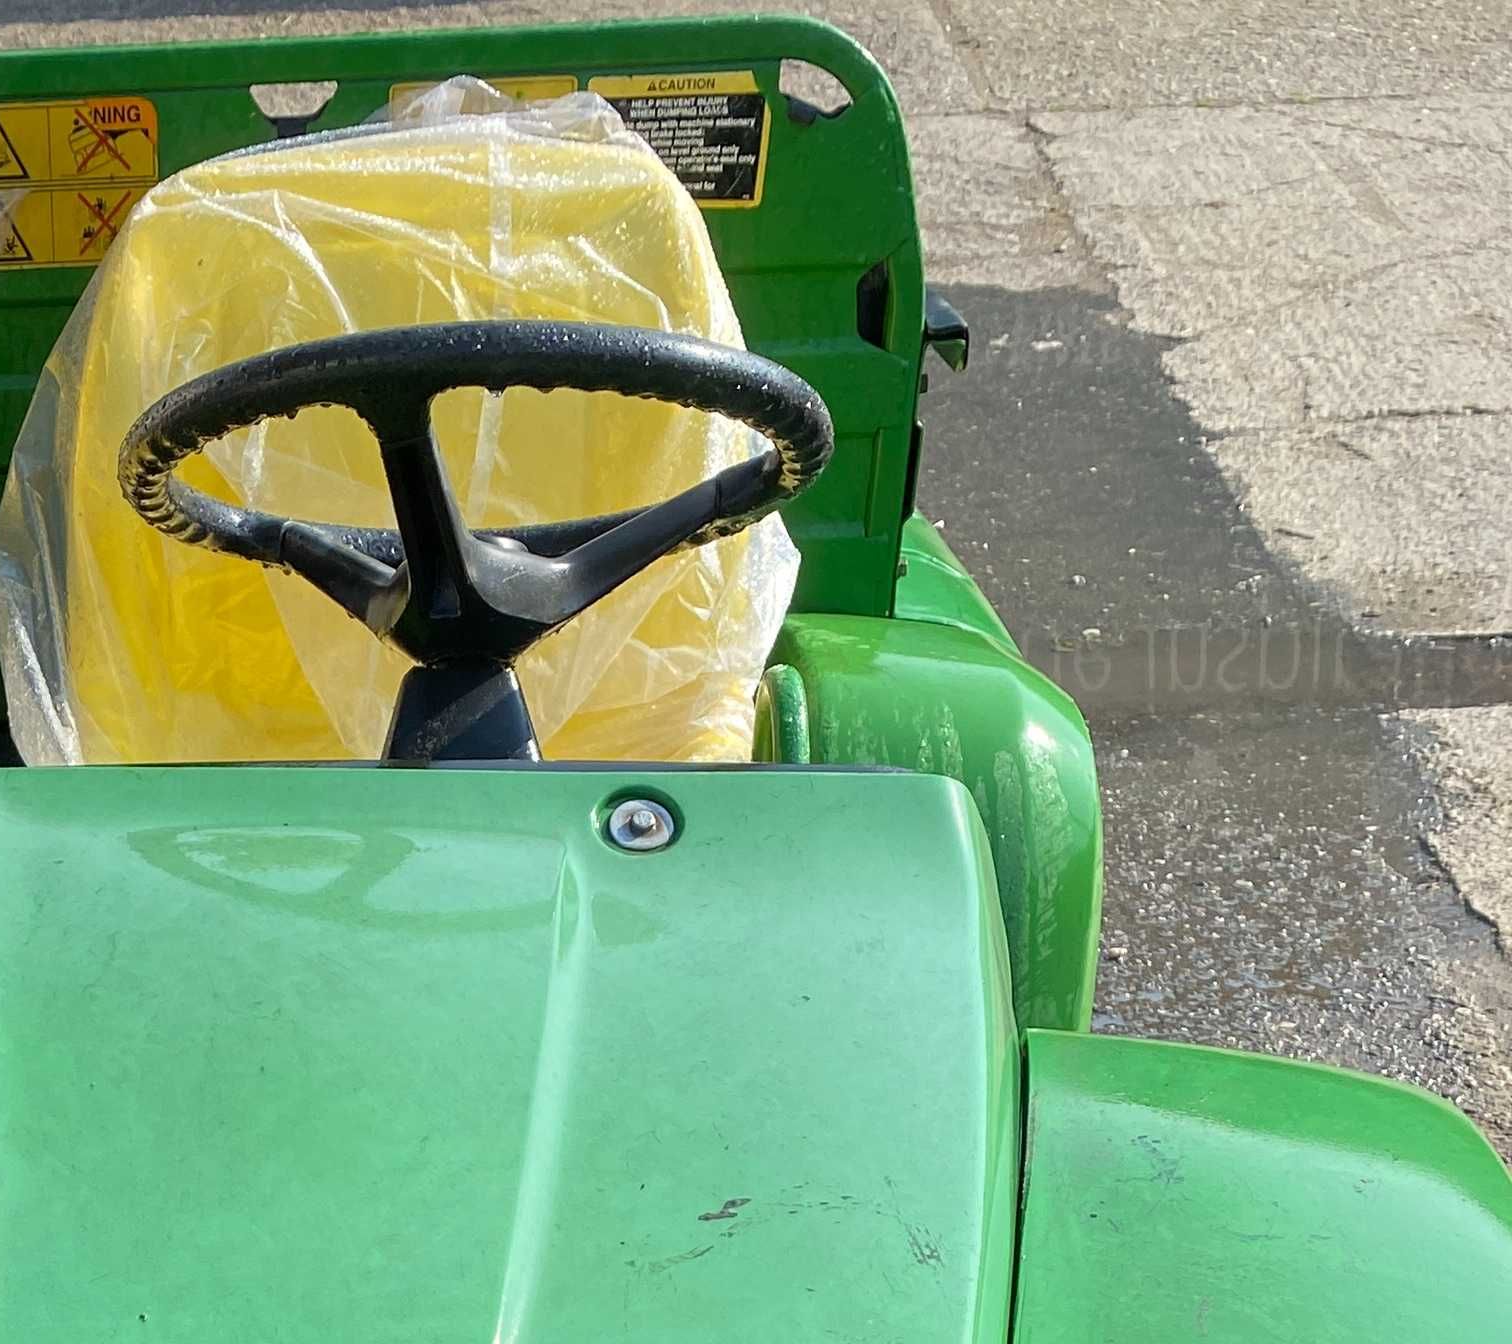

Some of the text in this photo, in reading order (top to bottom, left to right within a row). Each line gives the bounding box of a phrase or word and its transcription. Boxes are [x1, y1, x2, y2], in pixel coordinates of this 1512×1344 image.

[658, 78, 716, 92] CAUTION
[631, 95, 729, 108] HELP PREVENT INJURY
[92, 104, 141, 124] NING
[630, 105, 729, 118] WHEN DUMPING LOADS
